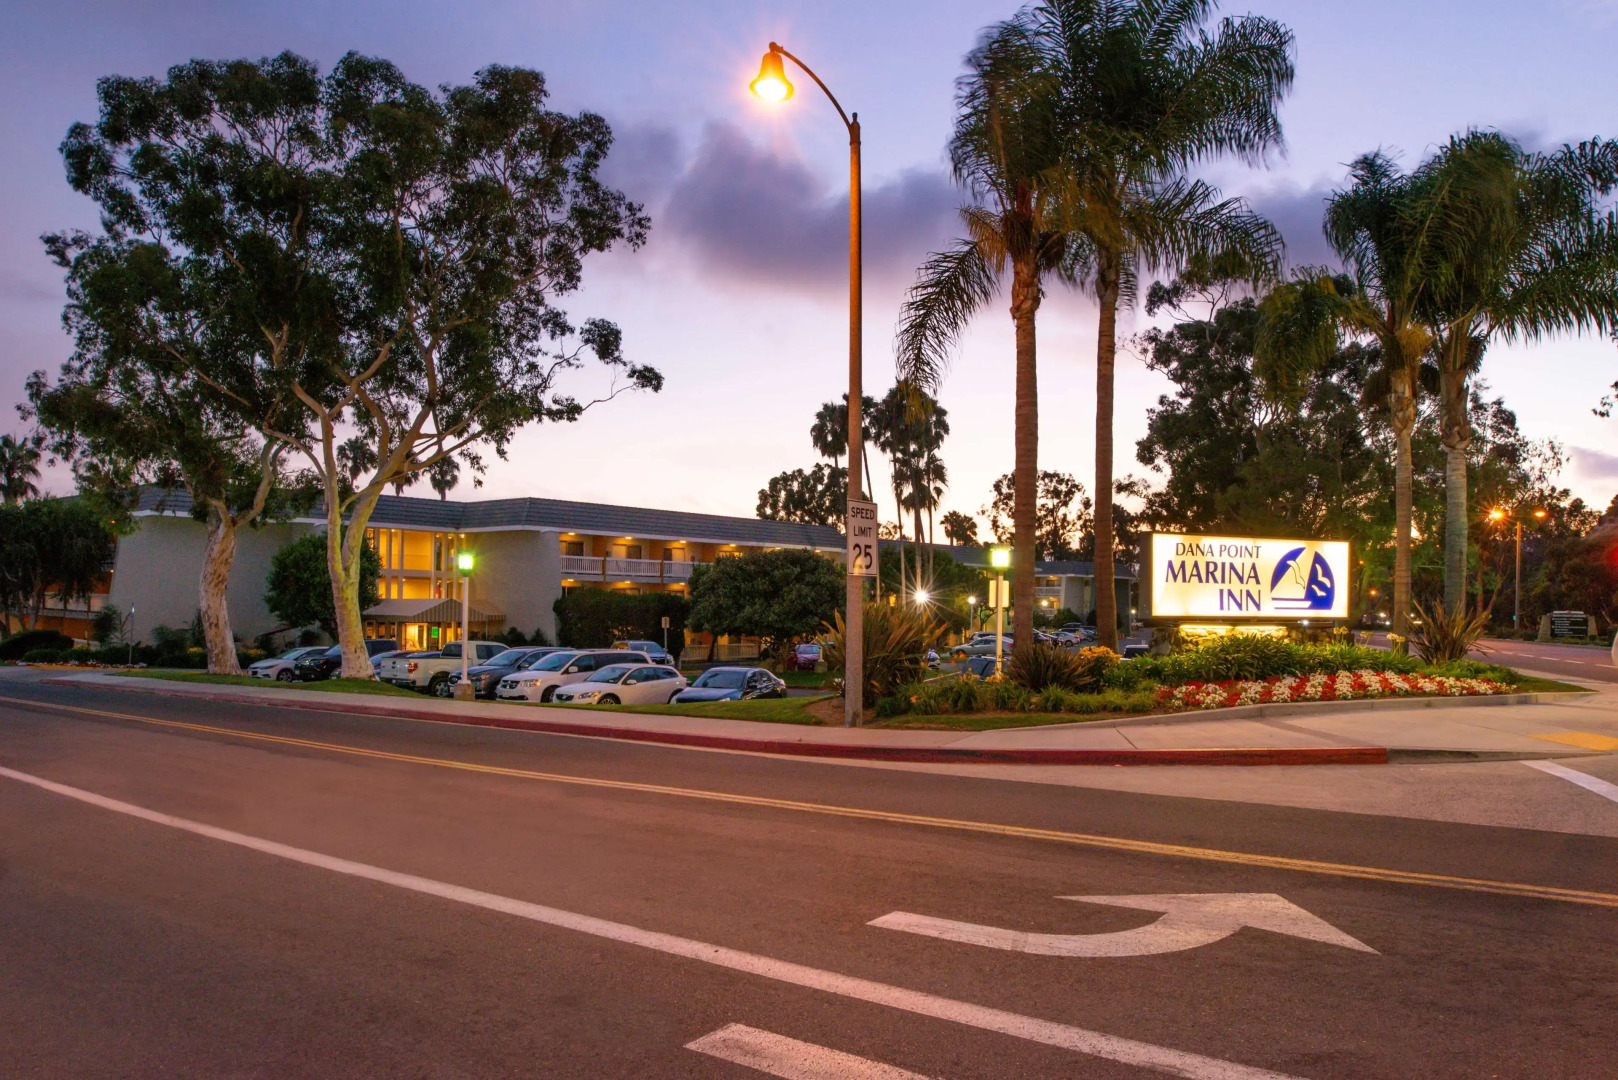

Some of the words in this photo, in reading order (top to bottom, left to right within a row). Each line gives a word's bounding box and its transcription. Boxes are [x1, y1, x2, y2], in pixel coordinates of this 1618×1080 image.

[851, 506, 874, 520] SPEED
[853, 525, 872, 538] LIMIT
[853, 543, 872, 570] 25
[1175, 542, 1214, 557] DANA
[1219, 544, 1261, 558] POINT
[1165, 559, 1261, 585] MARINA
[1219, 588, 1261, 611] INN
